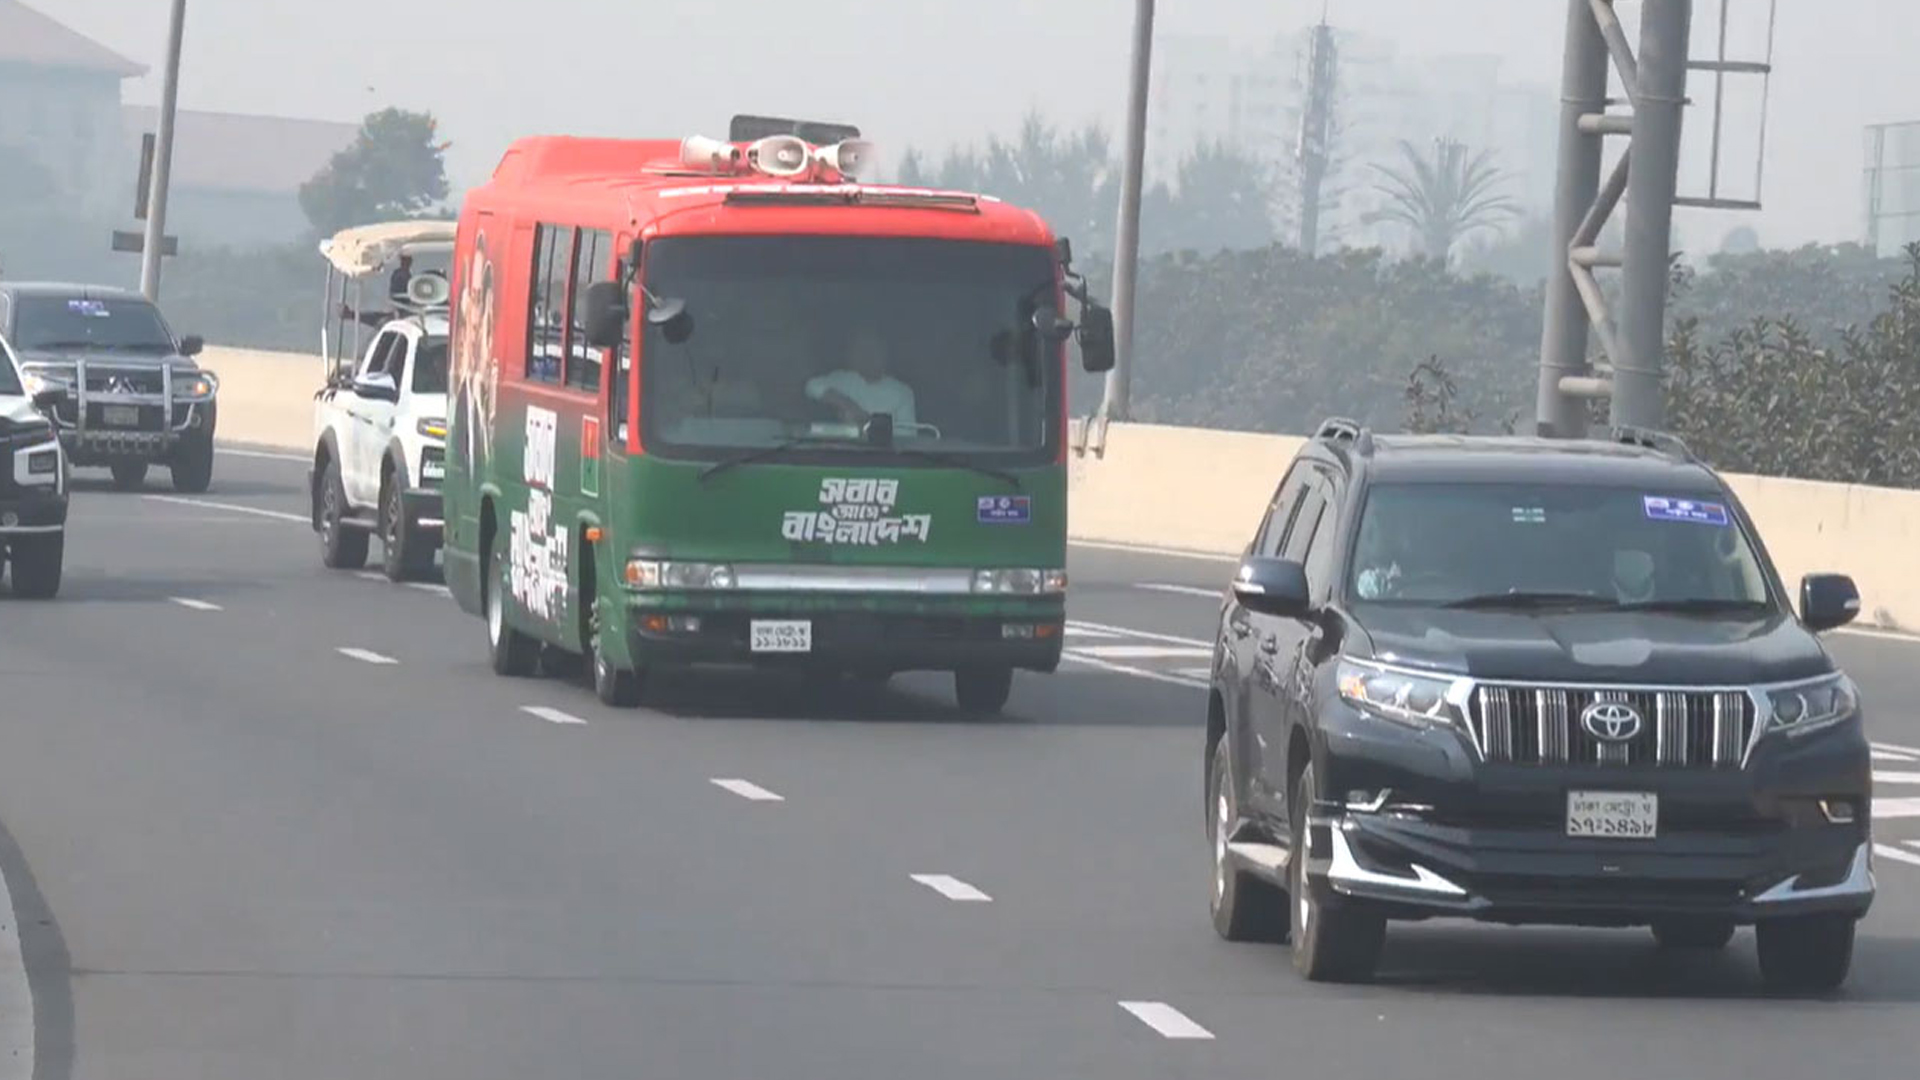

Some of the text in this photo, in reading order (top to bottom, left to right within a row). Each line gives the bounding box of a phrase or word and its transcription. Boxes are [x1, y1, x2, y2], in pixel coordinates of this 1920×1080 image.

[819, 478, 899, 512] সবার
[832, 503, 879, 519] আগে
[782, 511, 931, 545] বাংলাদেশ
